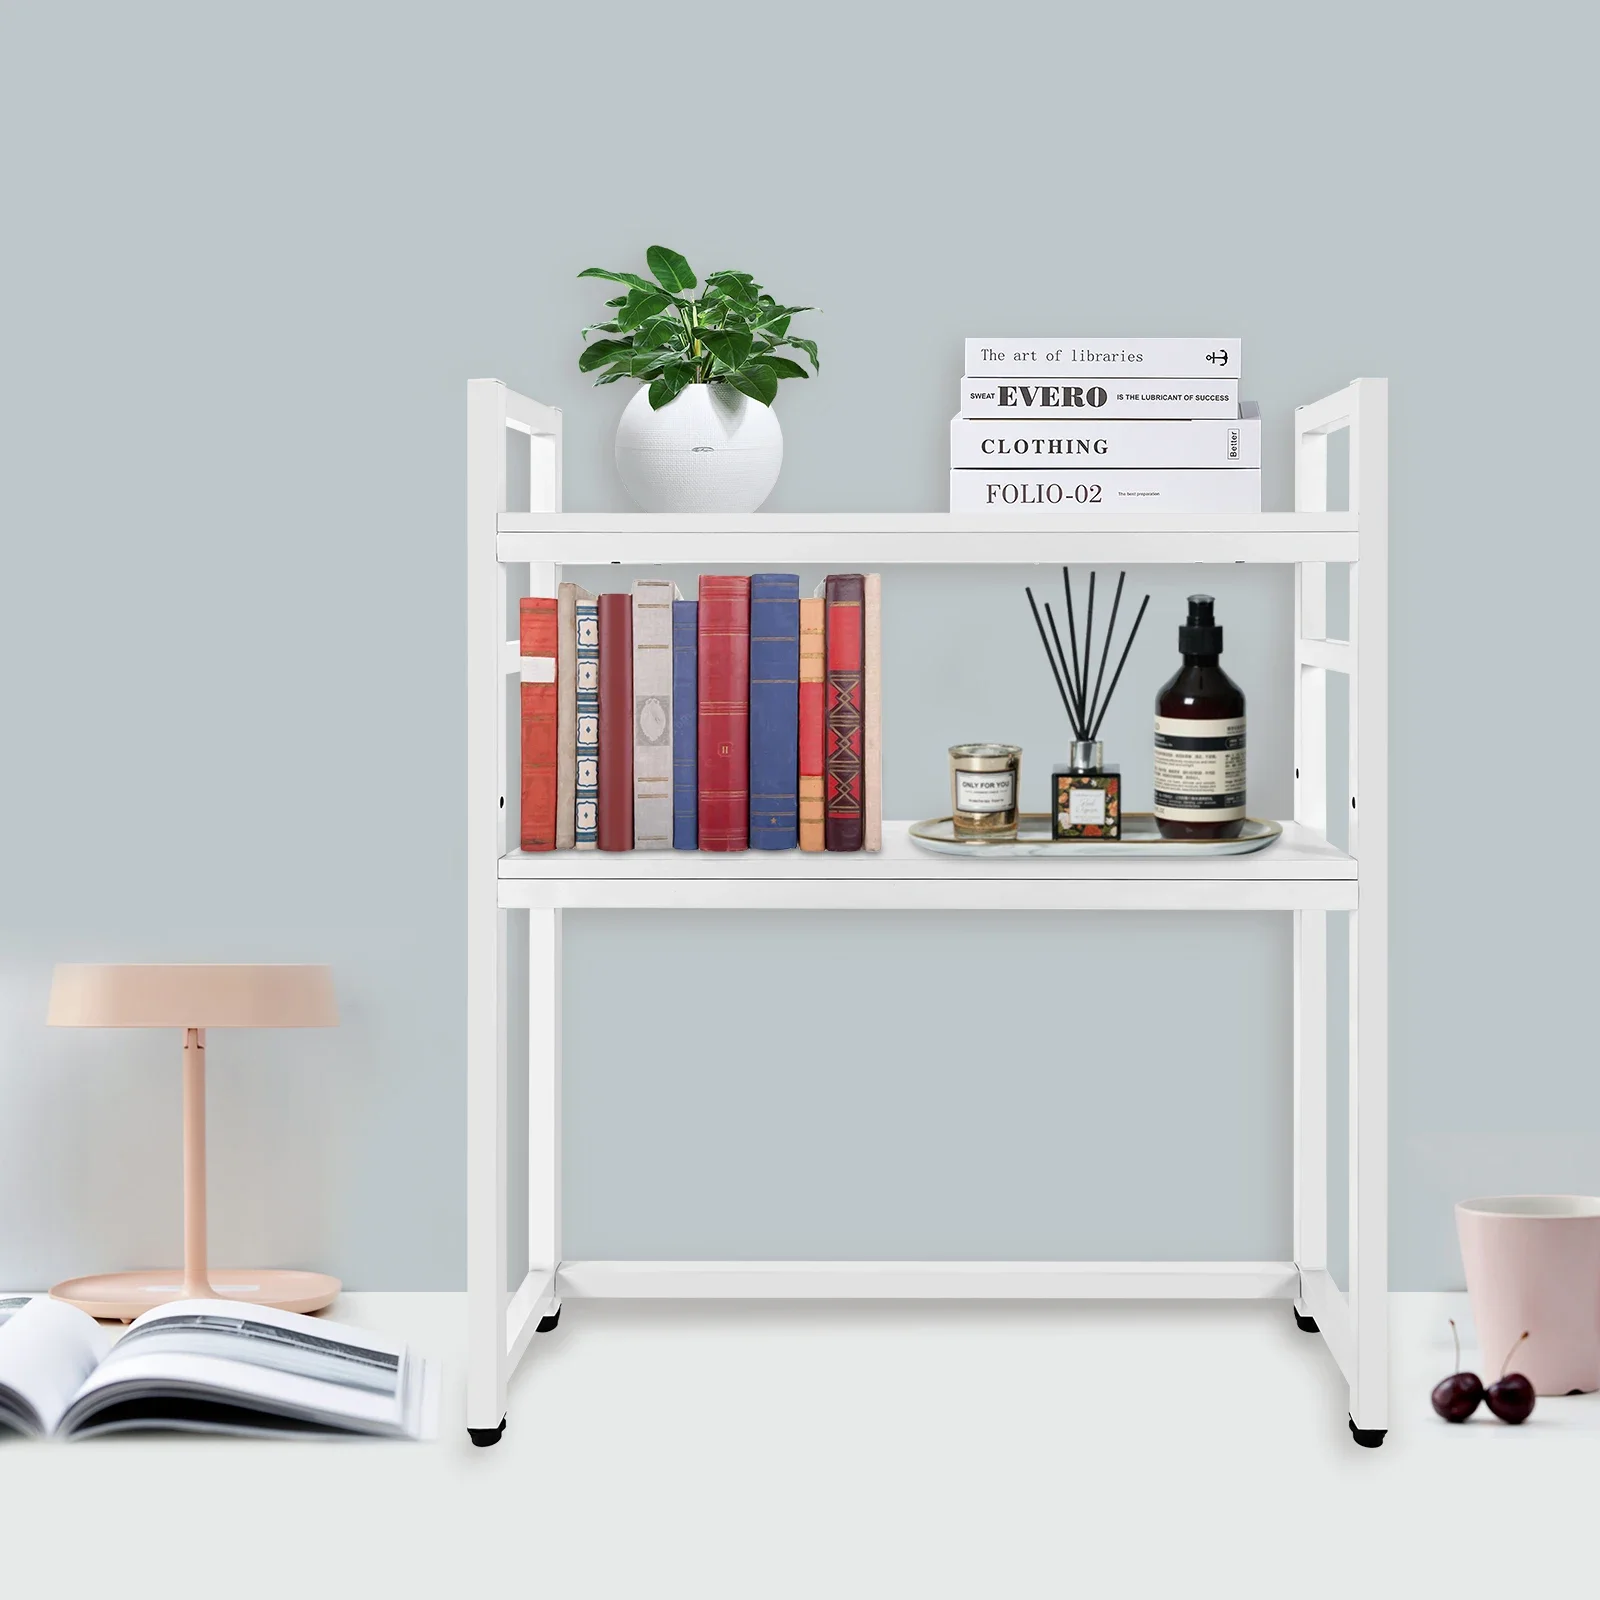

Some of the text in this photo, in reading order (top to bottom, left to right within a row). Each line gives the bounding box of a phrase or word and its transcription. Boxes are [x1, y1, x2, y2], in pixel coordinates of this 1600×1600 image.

[981, 348, 1144, 363] The art of libraries
[970, 392, 996, 400] SWEAT
[997, 385, 1108, 408] EVERO
[1116, 393, 1230, 402] IS THE LUBRICANT OF SUCCESS
[981, 438, 1109, 455] CLOTHING
[1229, 431, 1238, 458] Better
[986, 483, 1103, 505] FOLIO-02
[996, 780, 1010, 788] YOU
